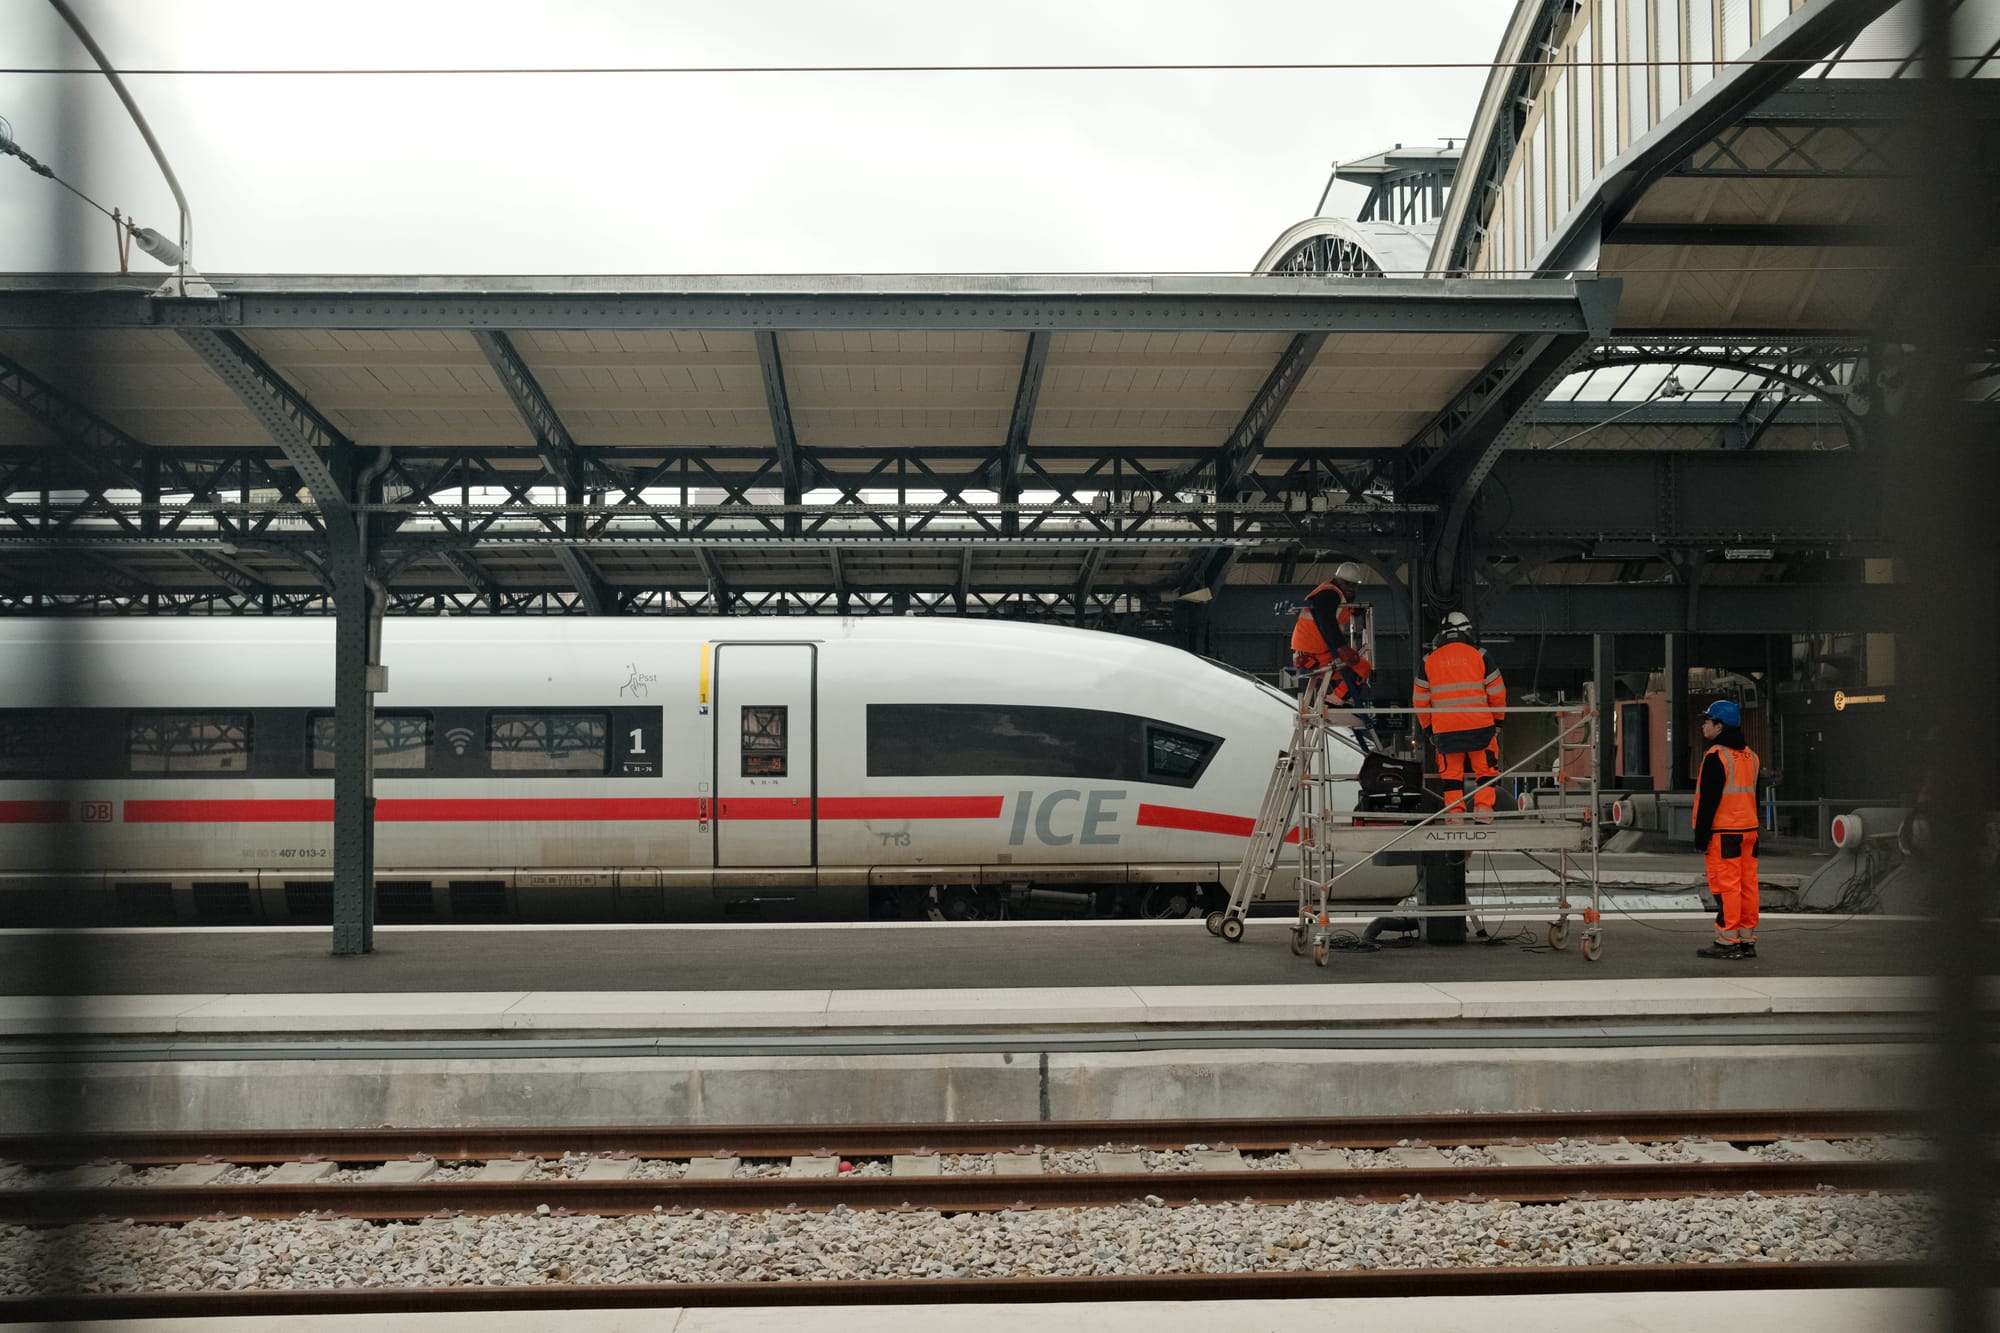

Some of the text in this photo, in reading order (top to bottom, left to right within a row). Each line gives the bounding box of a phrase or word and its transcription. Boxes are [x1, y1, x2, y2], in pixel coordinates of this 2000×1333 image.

[638, 673, 657, 682] Psst
[630, 728, 646, 754] 1
[85, 804, 110, 820] DB
[1008, 789, 1127, 846] ICE
[880, 831, 911, 847] 713
[279, 848, 296, 857] 407
[299, 848, 327, 857] 013-2
